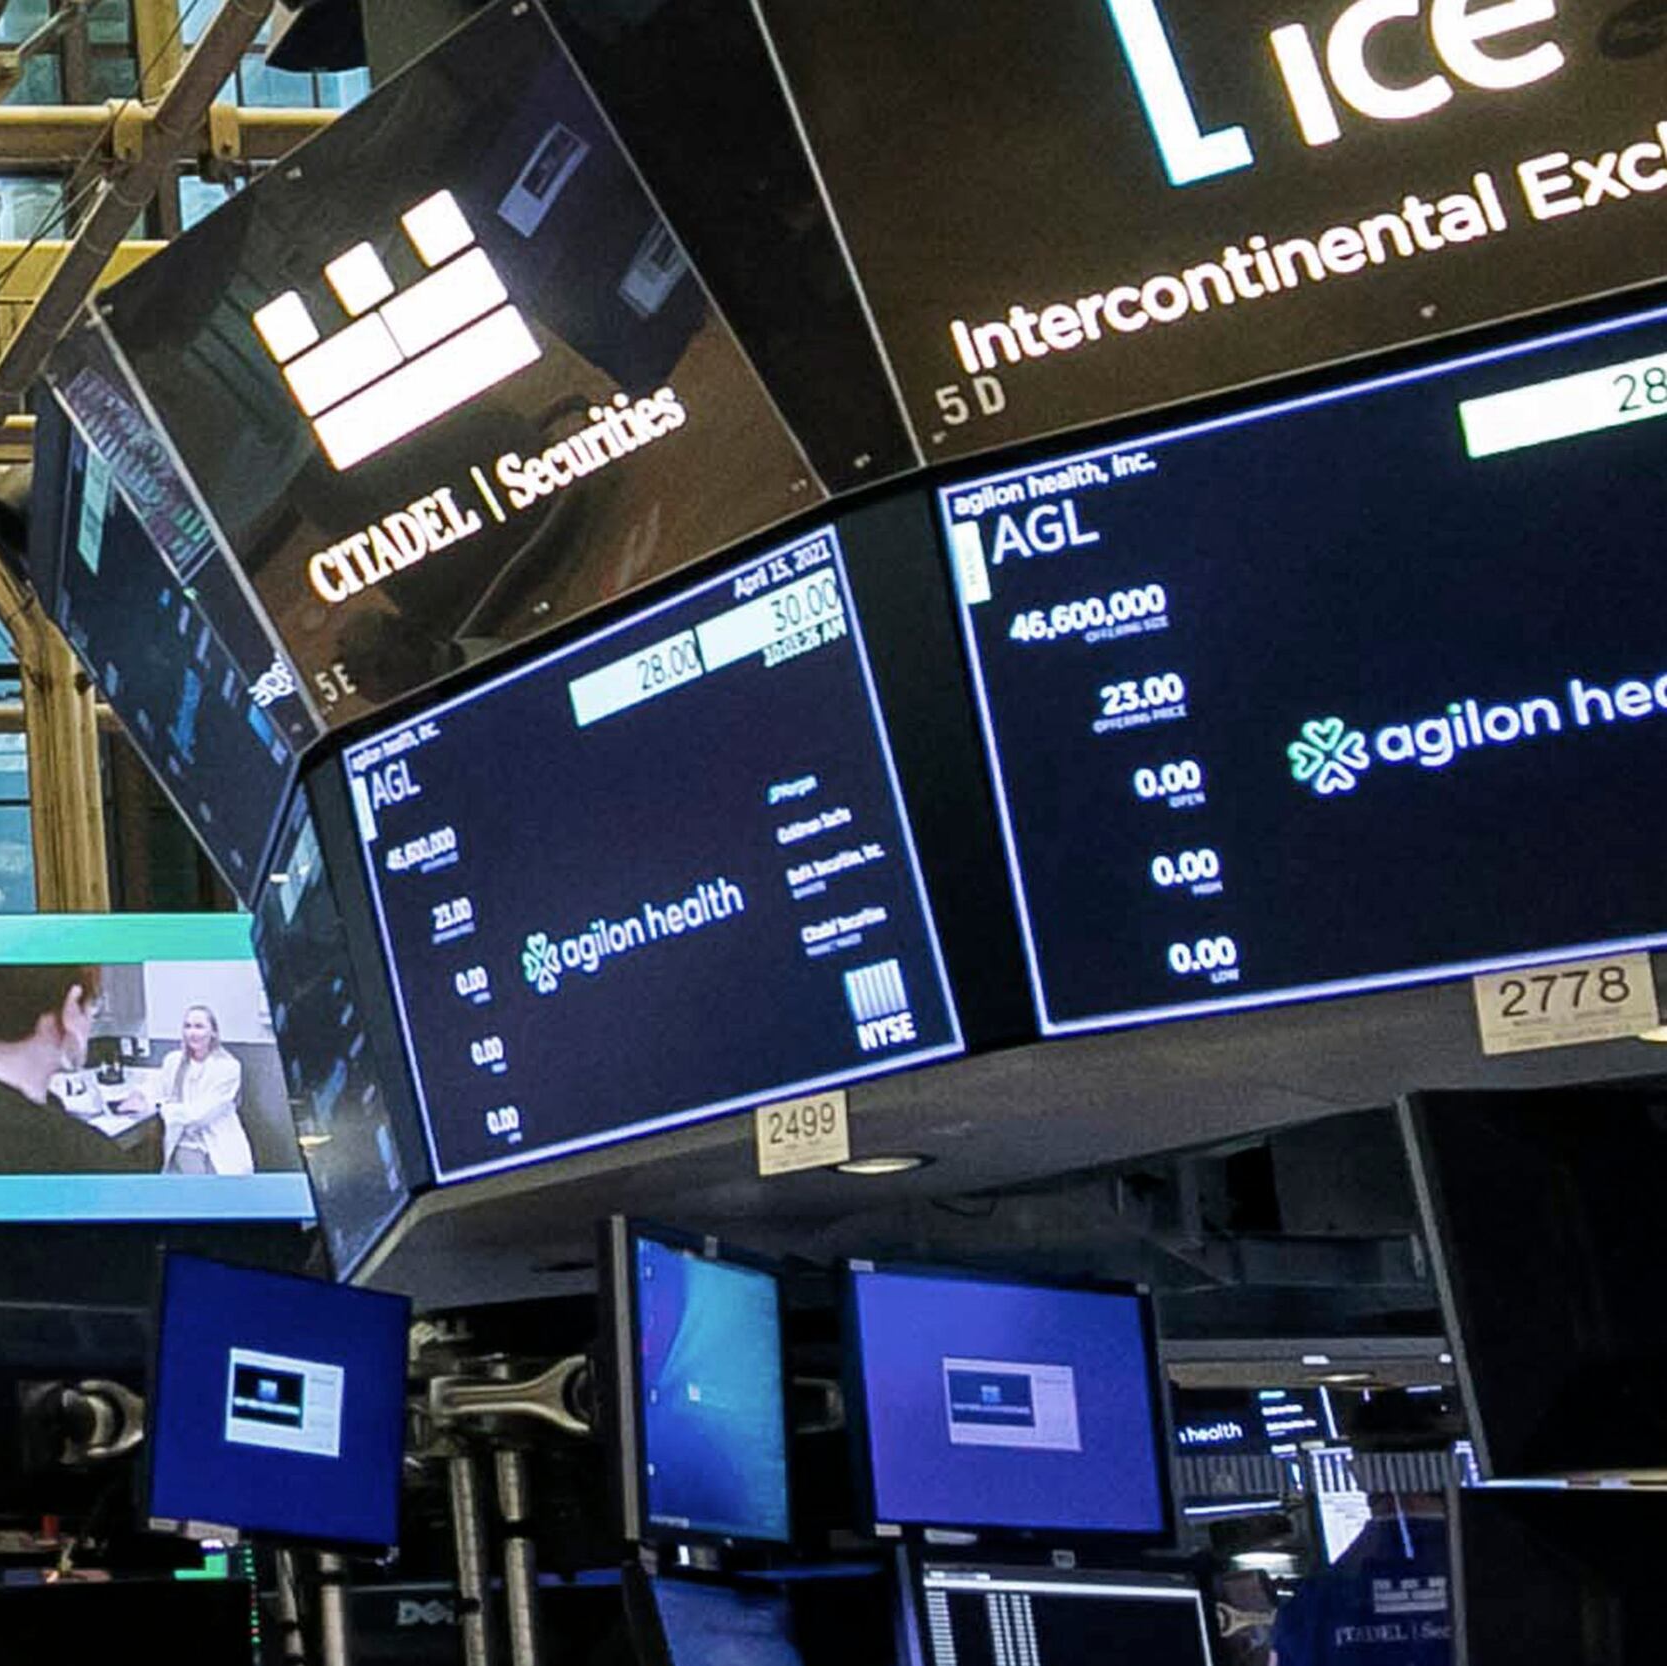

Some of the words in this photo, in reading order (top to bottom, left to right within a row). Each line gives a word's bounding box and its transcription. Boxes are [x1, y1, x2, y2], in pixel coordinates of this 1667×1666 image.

[951, 172, 1507, 374] Intercontinental
[308, 486, 482, 604] CITADEL
[496, 386, 686, 509] Securities
[953, 482, 1025, 516] agilon
[1027, 461, 1108, 499] health,
[991, 499, 1100, 565] AGL
[771, 578, 839, 633] 30.00
[1009, 584, 1167, 643] 46,600,000
[637, 639, 699, 691] 28.00
[1101, 673, 1185, 716] 23.00
[1376, 698, 1561, 767] agilon
[371, 759, 421, 811] AGL
[1134, 759, 1202, 799] 0.00
[1152, 849, 1220, 887] 0.00
[561, 916, 646, 975] agilon
[646, 876, 744, 939] health
[1169, 936, 1237, 973] 0.00
[1500, 966, 1630, 1018] 2778
[856, 1011, 917, 1052] NYSE
[769, 1102, 836, 1145] 2499
